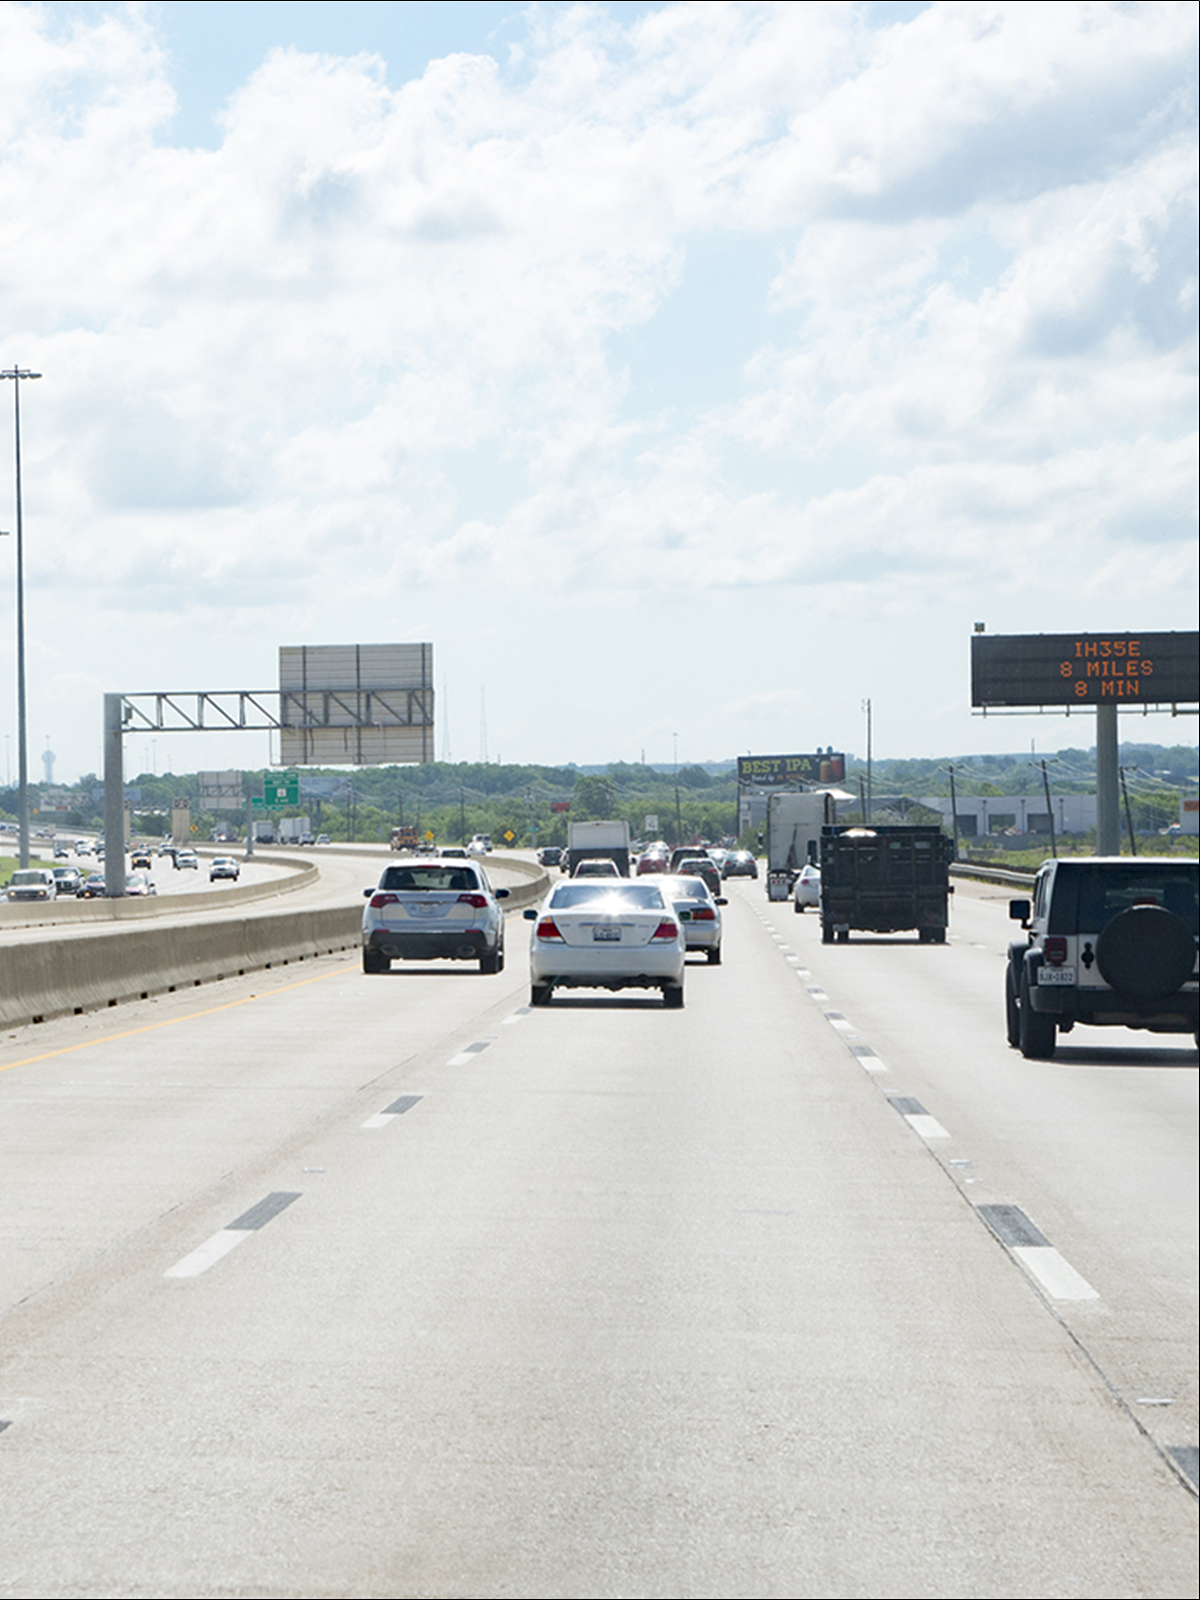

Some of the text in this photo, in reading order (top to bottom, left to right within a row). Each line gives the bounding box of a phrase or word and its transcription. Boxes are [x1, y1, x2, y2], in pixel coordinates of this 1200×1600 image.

[1074, 640, 1141, 658] IH35E
[1060, 659, 1154, 678] 8 MILES
[1074, 680, 1140, 697] 8 MIN
[741, 758, 813, 775] BEST IPA
